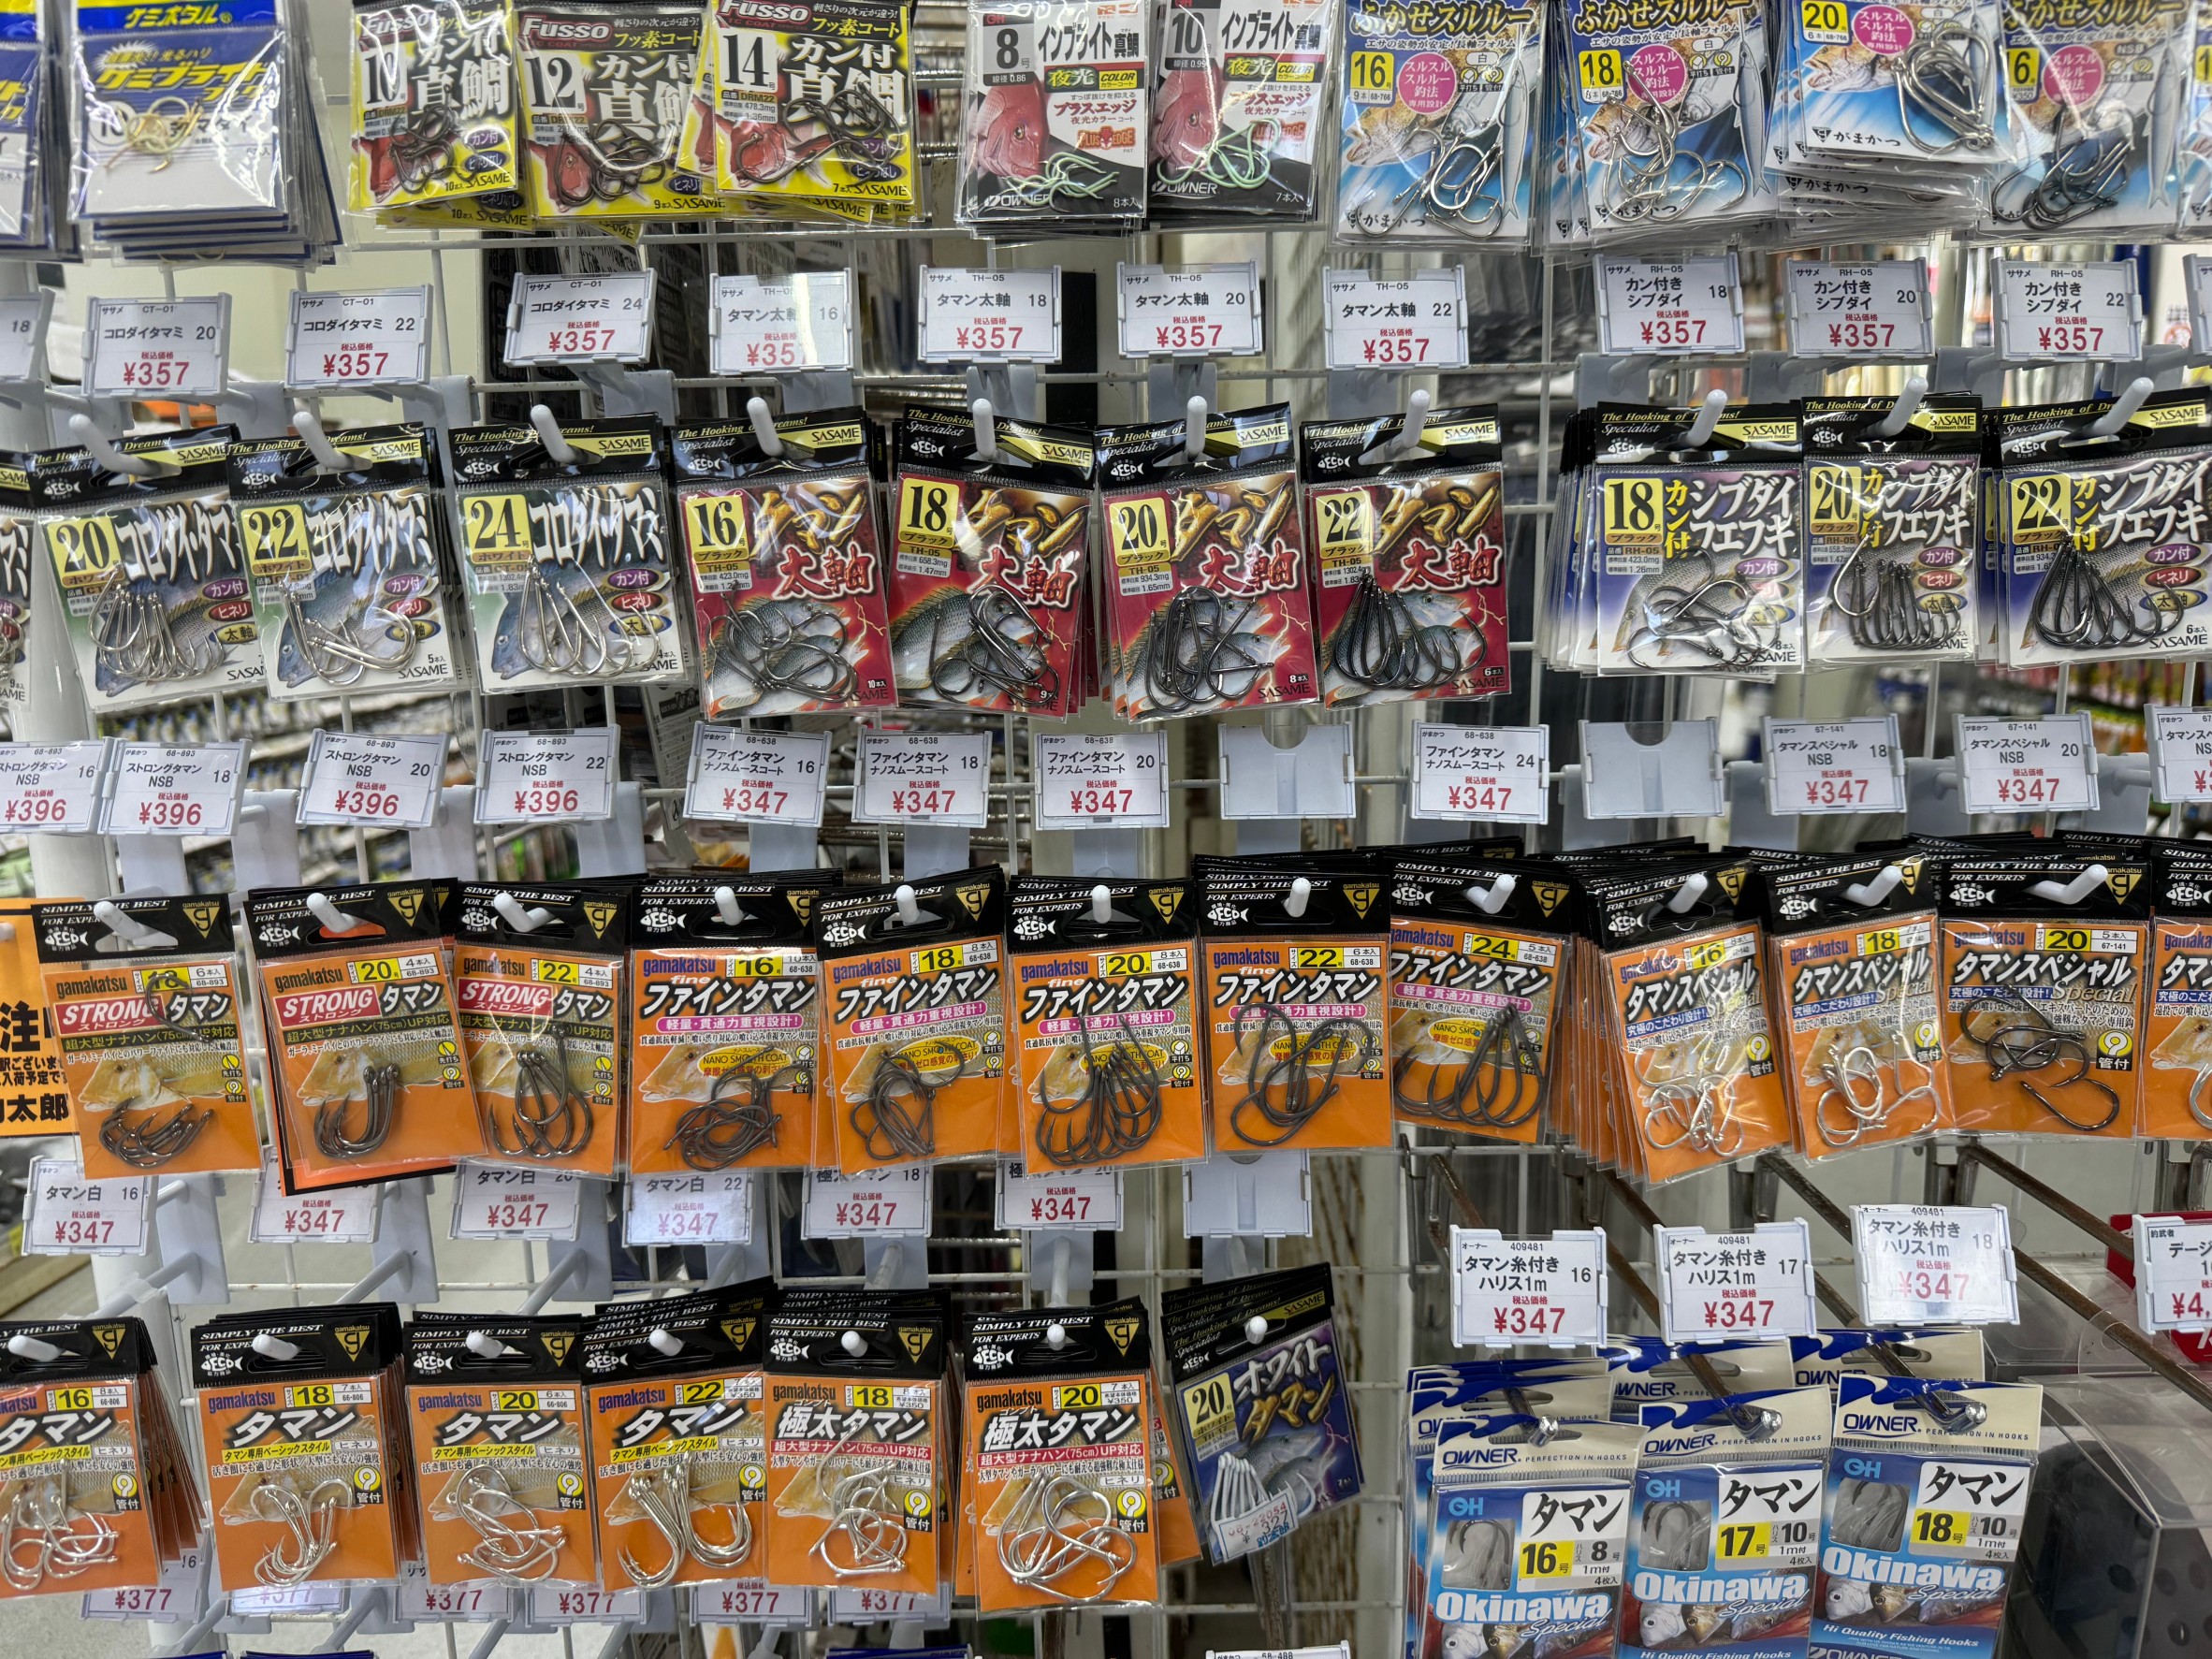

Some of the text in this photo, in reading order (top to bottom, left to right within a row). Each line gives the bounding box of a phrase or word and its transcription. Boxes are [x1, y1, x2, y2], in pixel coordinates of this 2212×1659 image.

[812, 19, 900, 37] フッ素コート
[793, 38, 896, 68] カン付
[1047, 68, 1096, 88] 夜光
[1100, 72, 1135, 82] COLOR
[741, 93, 775, 103] DRM22
[1054, 100, 1137, 116] プラスエッジ
[1834, 132, 1899, 146] がまかつ
[854, 183, 907, 196] SASAME
[1625, 277, 1681, 292] カン付き
[1709, 284, 1727, 298] 18
[2025, 282, 2081, 296] カン付き
[938, 293, 1046, 308] タマン太軸 18
[1136, 292, 1244, 307] タマン太軸 20
[1627, 293, 1682, 307] シブダイ
[1897, 290, 1915, 303] 20
[2106, 293, 2124, 307] 22
[102, 305, 124, 314] ササメ
[531, 298, 642, 313] コロダイタマミ 24
[1342, 303, 1451, 319] タマン太軸 22
[2027, 298, 2080, 313] シブダイ
[304, 318, 415, 332] コロダイタマミ 22
[1641, 320, 1707, 344] ¥357
[104, 326, 215, 341] コロダイタマミ 20
[957, 327, 1023, 349] ¥357
[1157, 325, 1222, 347] ¥357
[1830, 324, 1895, 347] ¥357
[2039, 327, 2103, 351] ¥357
[324, 353, 389, 376] ¥357
[124, 361, 189, 386] ¥357
[2003, 408, 2074, 423] The Hooking
[2150, 407, 2203, 422] SASAME
[906, 421, 965, 438] Specialist
[1742, 424, 1795, 436] SASAME
[599, 438, 649, 451] SASAME
[1041, 444, 1091, 461] SASAME
[1691, 476, 1796, 510] シブダイ
[1690, 516, 1795, 555] フエフキ
[910, 546, 940, 557] TH-05
[1625, 546, 1659, 555] RH-05
[2154, 546, 2190, 560] カン付
[1128, 565, 1159, 575] TH-05
[1201, 544, 1291, 596] 太軸
[1629, 565, 1659, 574] 1.26mm
[2150, 634, 2207, 648] SASAME
[1779, 739, 1857, 751] タマンスペシャル
[1870, 745, 1887, 757] 18
[1971, 738, 2050, 749] タマンスペシャル
[2061, 743, 2079, 757] 20
[326, 750, 400, 764] ストロングタマン
[498, 752, 575, 764] ストロングタマン
[871, 752, 948, 763] ファインタマン
[1048, 751, 1125, 763] ファインタマン
[1426, 746, 1505, 759] ファインタマン
[2000, 752, 2024, 764] NSB
[587, 757, 604, 769] 22
[797, 761, 815, 773] 16
[961, 756, 978, 768] 18
[1137, 755, 1155, 768] 20
[1426, 760, 1505, 771] ナノスムースコート
[1517, 754, 1535, 767] 24
[78, 765, 94, 778] 16
[126, 764, 201, 774] ストロングタマン
[213, 770, 229, 782] 18
[411, 764, 429, 776] 20
[522, 765, 546, 776] NSB
[871, 764, 949, 775] ナノスムースコート
[1048, 764, 1125, 775] ナノスムースコート
[149, 776, 173, 787] NSB
[1448, 786, 1511, 810] ¥347
[1807, 779, 1869, 805] ¥347
[515, 790, 578, 813] ¥396
[723, 788, 788, 813] ¥347
[894, 791, 955, 812] ¥347
[1070, 790, 1132, 813] ¥347
[6, 799, 66, 822] ¥396
[139, 803, 202, 825] ¥396
[644, 956, 716, 975] gamakatsu
[1214, 949, 1279, 968] gamakatsu
[407, 968, 434, 978] 68-893
[1954, 953, 2132, 985] タマンスペシャル
[275, 968, 343, 993] gamakatsu
[1217, 972, 1378, 1004] ファインタマン
[284, 983, 442, 1017] STRONG タマン
[1026, 977, 1186, 1019] ファインタマン
[47, 1186, 138, 1201] タマン白 16
[837, 1202, 897, 1226] ¥347
[1031, 1197, 1091, 1220] ¥347
[55, 1221, 114, 1244] ¥347
[1869, 1219, 1960, 1237] タマン糸付き
[1510, 1243, 1544, 1251] 409481
[1972, 1234, 1993, 1249] 18
[1464, 1256, 1559, 1273] タマン糸付き
[1673, 1250, 1766, 1266] タマン糸付き
[1779, 1259, 1797, 1274] 17
[1571, 1268, 1591, 1283] 16
[1688, 1270, 1755, 1285] ハリス1m
[1479, 1276, 1547, 1291] ハリス1m
[1494, 1308, 1565, 1333] ¥347
[1704, 1300, 1774, 1327] ¥347
[771, 1317, 820, 1328] SIMPLY
[853, 1320, 888, 1329] BEST
[209, 1391, 275, 1413] gamakatsu
[418, 1392, 482, 1412] gamakatsu
[233, 1408, 355, 1448] タマン
[984, 1407, 1135, 1450] 極太タマン
[1843, 1413, 1917, 1432] OWNER
[434, 1447, 535, 1459] タマン専用ベーシックスタイル
[543, 1446, 575, 1455] ヒネリ
[1443, 1449, 1517, 1464] OWNER
[1923, 1466, 2025, 1506] タマン
[1530, 1492, 1624, 1536] タマン
[1823, 1550, 2004, 1589] Okinawa
[115, 1589, 171, 1610] ¥377
[721, 1591, 779, 1613] ¥377
[1436, 1593, 1610, 1622] Okinawa
[1824, 1624, 1839, 1634] Hi
[1841, 1625, 1887, 1641] Quality
[1890, 1631, 1936, 1645] Fishing
[1939, 1637, 1979, 1647] Hooks
